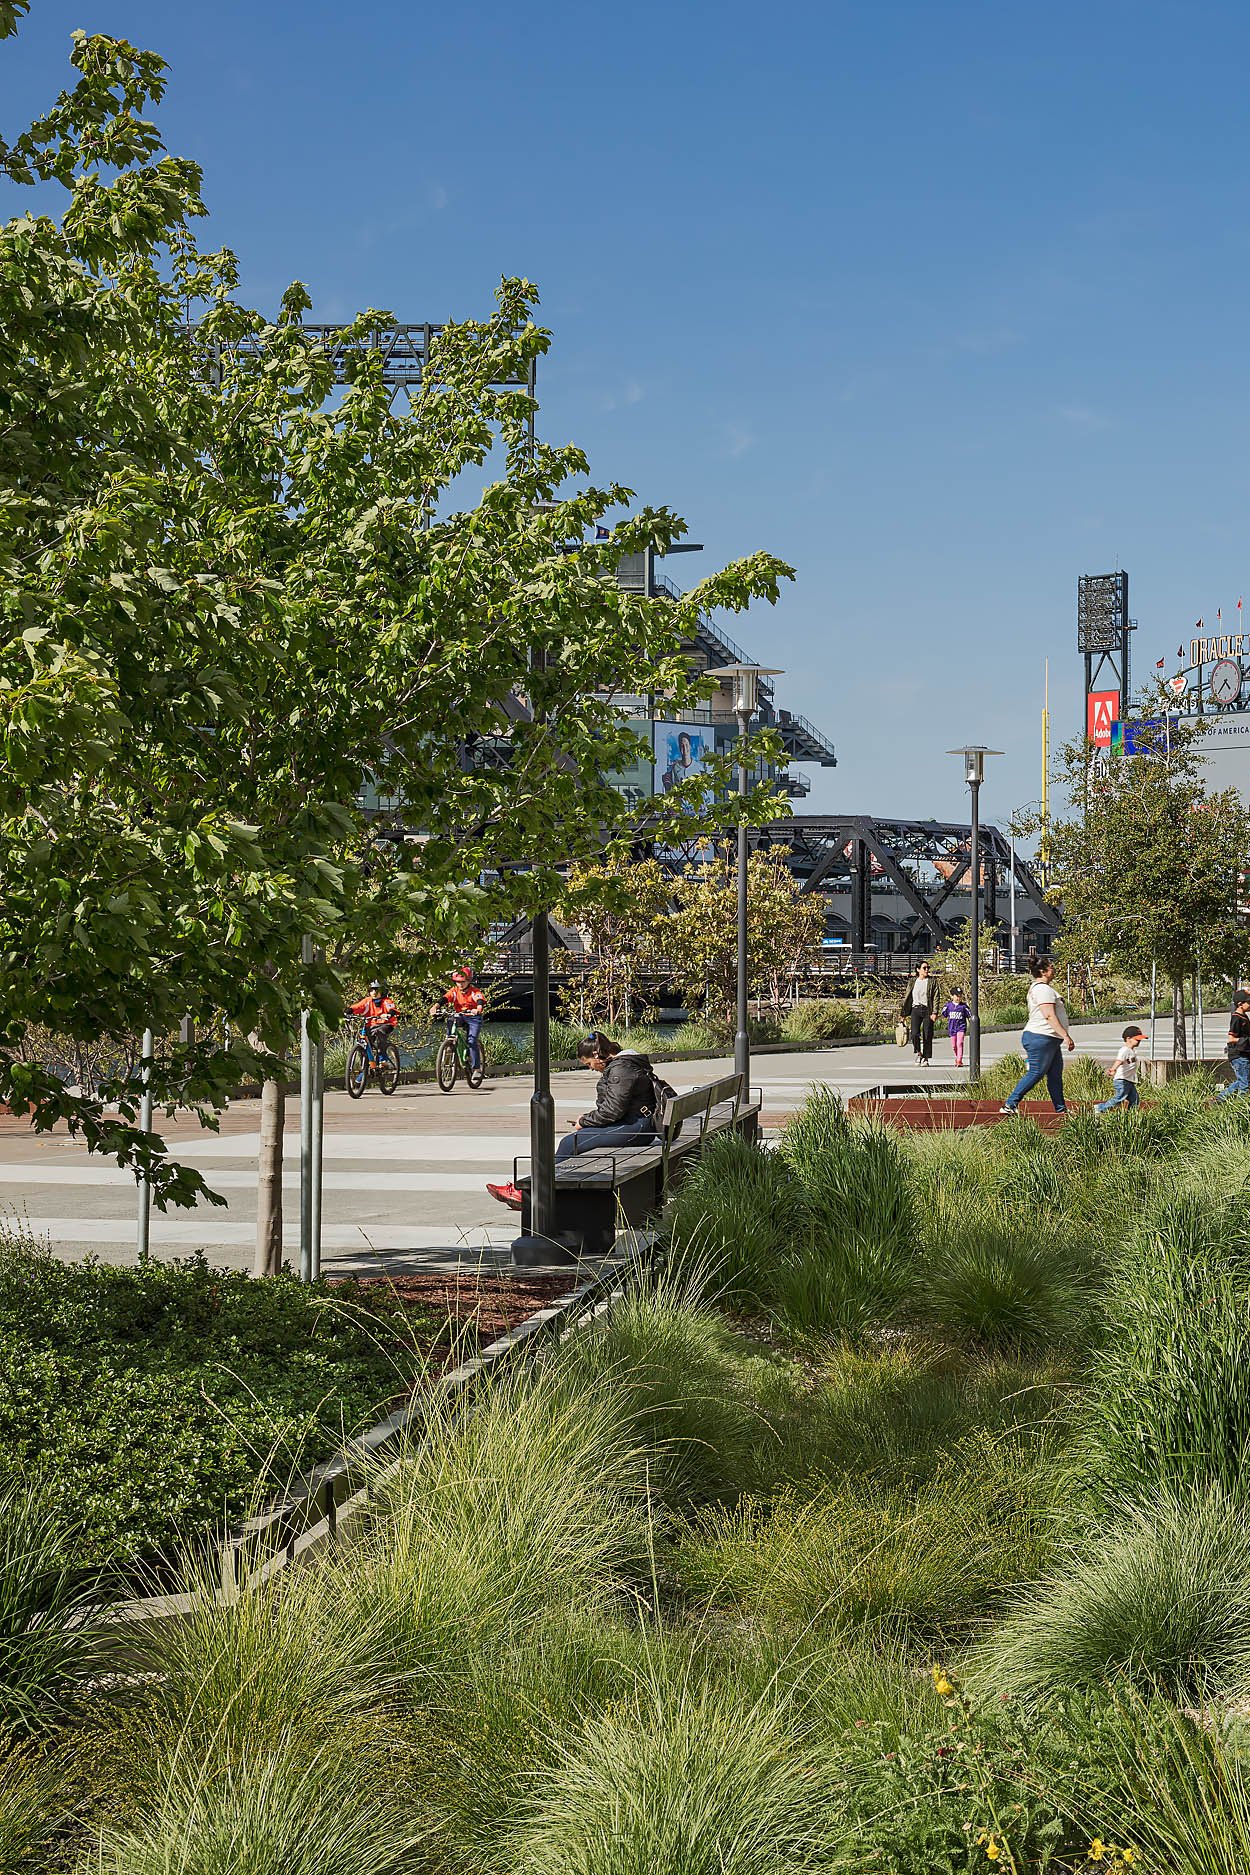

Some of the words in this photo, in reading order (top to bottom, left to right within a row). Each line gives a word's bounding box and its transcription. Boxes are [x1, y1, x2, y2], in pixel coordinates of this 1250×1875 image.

[1190, 634, 1244, 667] ORACLE
[1207, 728, 1217, 736] OF
[1217, 726, 1250, 735] AMERICA
